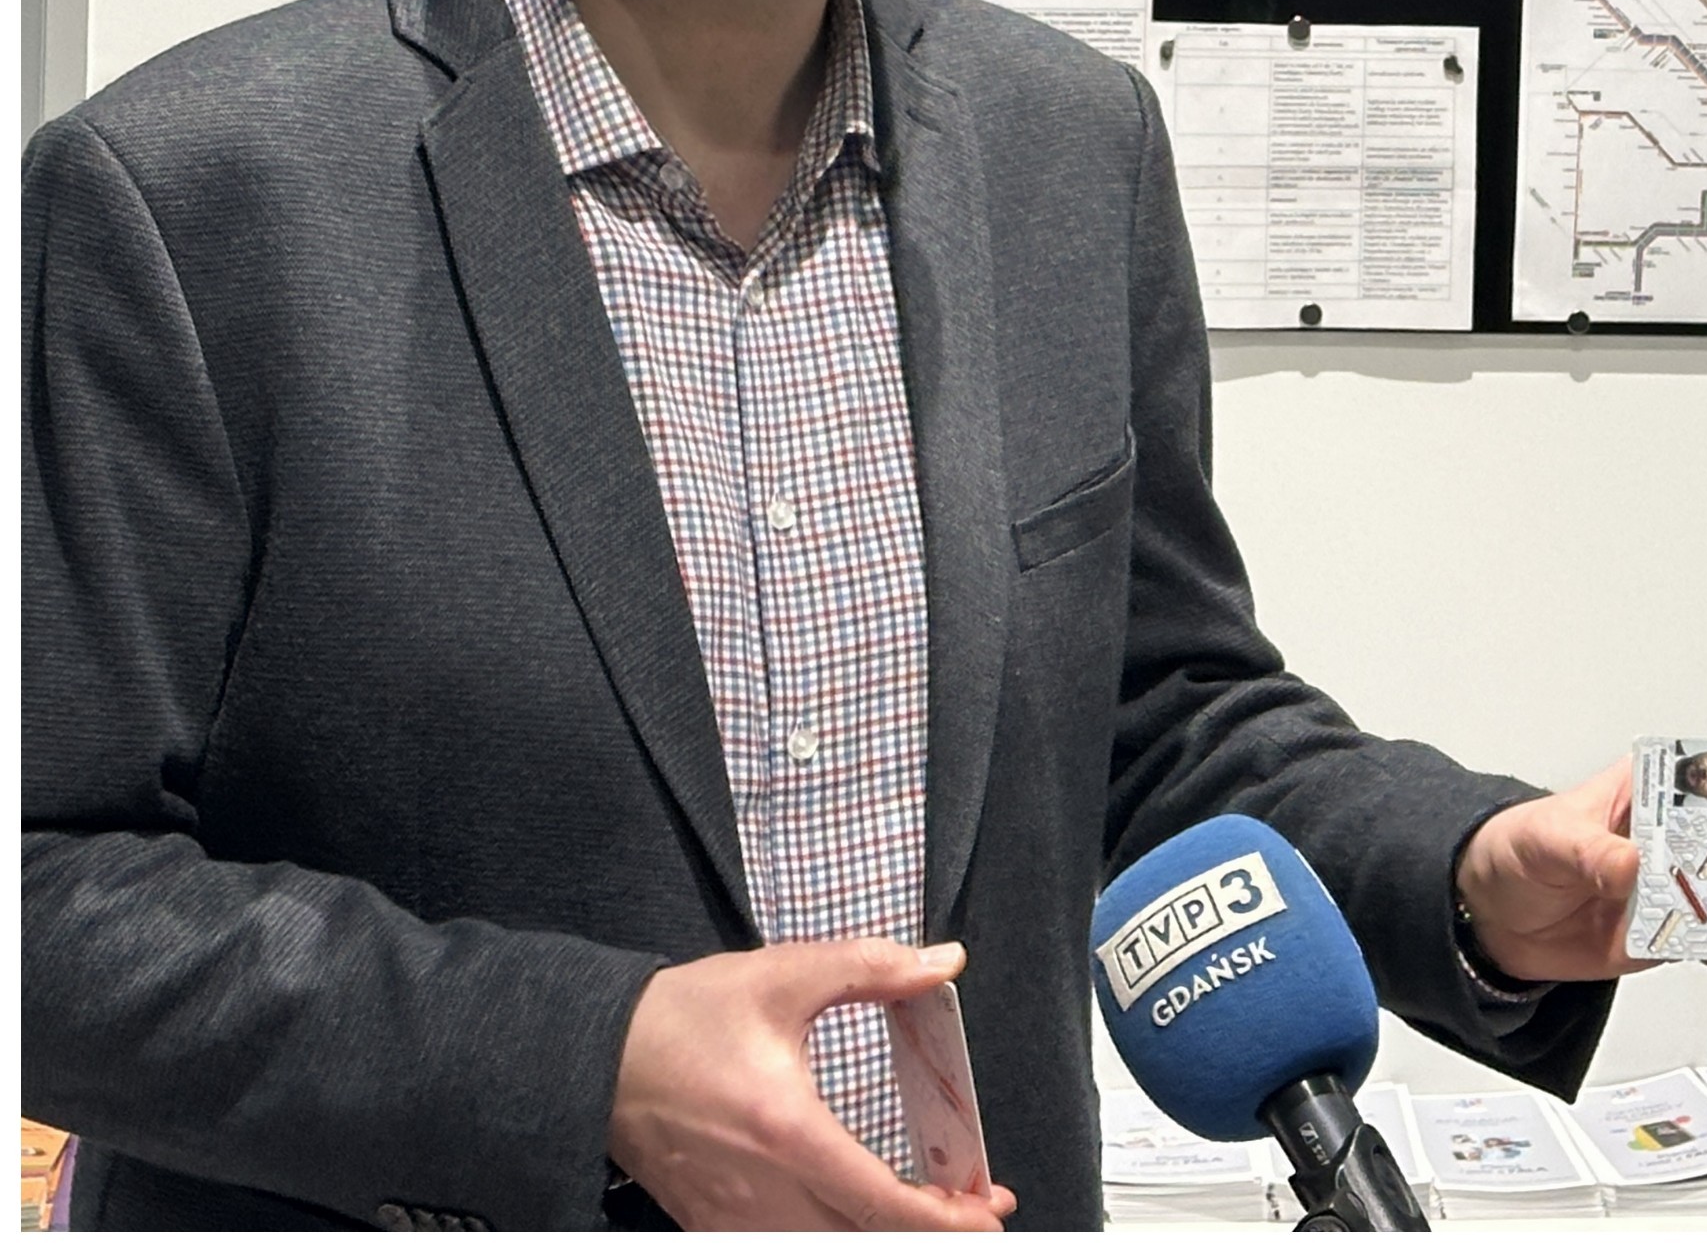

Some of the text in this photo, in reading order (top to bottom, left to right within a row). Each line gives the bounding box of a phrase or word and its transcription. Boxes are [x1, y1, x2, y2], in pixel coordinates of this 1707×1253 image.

[1122, 868, 1263, 970] TVP 3
[1152, 936, 1276, 1027] GDAŃSK
